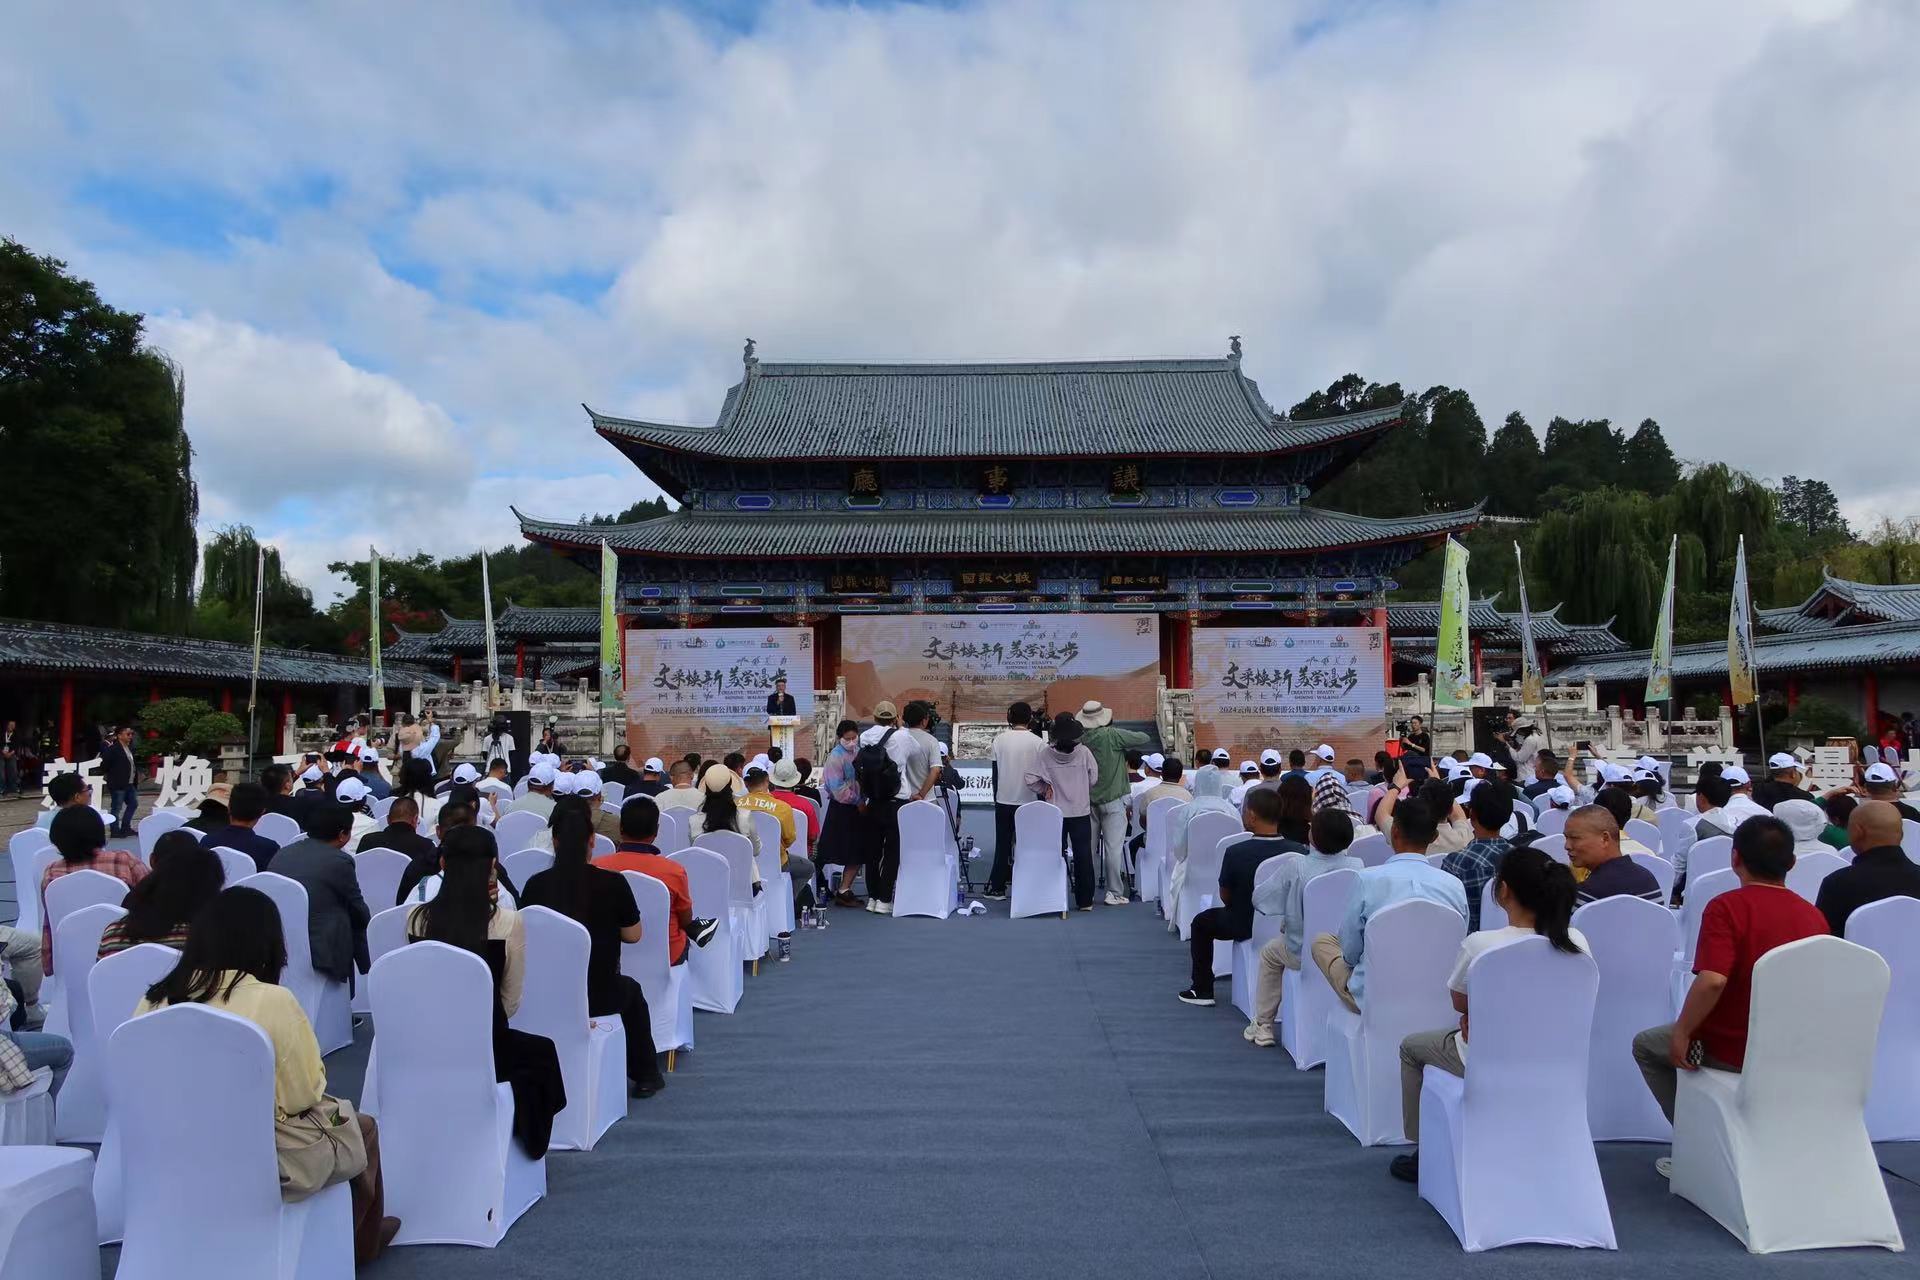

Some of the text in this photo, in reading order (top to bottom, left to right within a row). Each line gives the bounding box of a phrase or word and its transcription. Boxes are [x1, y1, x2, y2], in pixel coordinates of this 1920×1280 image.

[922, 636, 1079, 667] 文采焕新 美学漫步
[653, 663, 723, 695] 文采焕新
[1222, 662, 1358, 696] 文采焕新 美学漫步
[755, 797, 777, 812] TEAM
